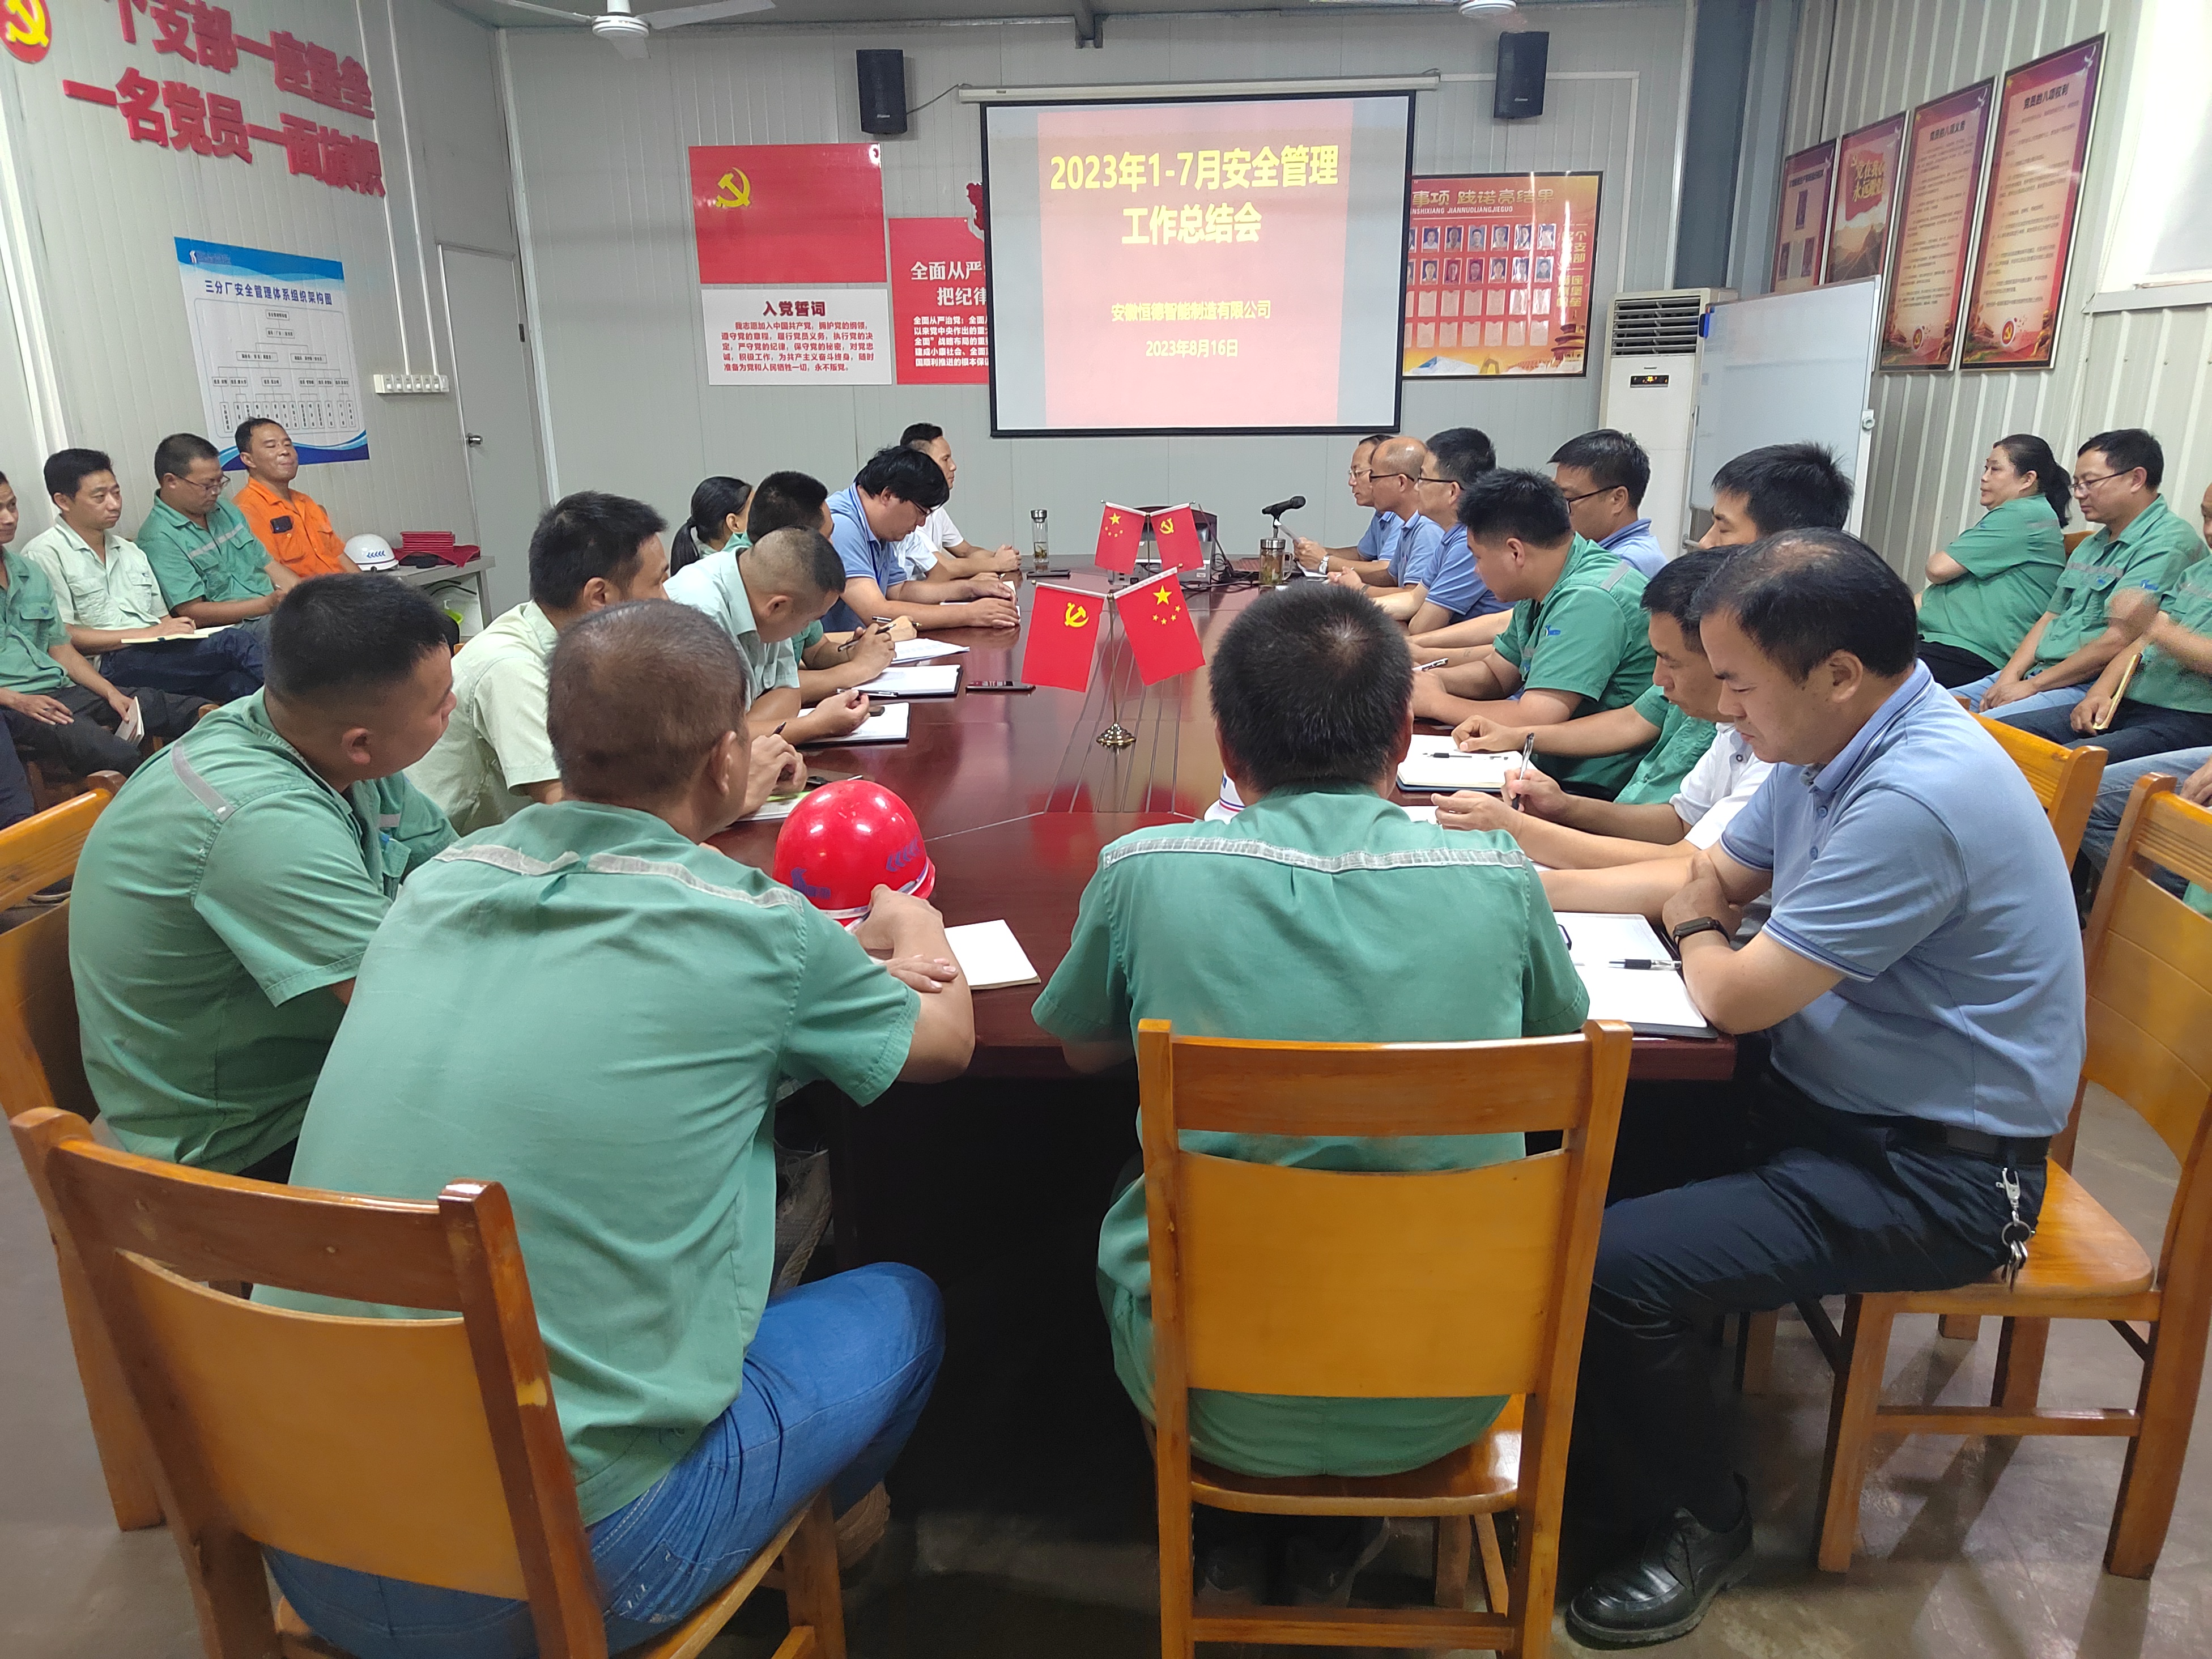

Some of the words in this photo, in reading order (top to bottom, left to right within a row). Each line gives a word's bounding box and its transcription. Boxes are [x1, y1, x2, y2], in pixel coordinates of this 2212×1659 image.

[1050, 145, 1339, 193] 2023年1-7月安全管理
[1121, 202, 1262, 245] 工作总结会
[911, 261, 985, 280] 全面从严
[205, 280, 333, 305] 三分厂安全管理体系组织架构图
[763, 301, 826, 317] 入党誓词
[1146, 339, 1238, 358] 2023年8月16日
